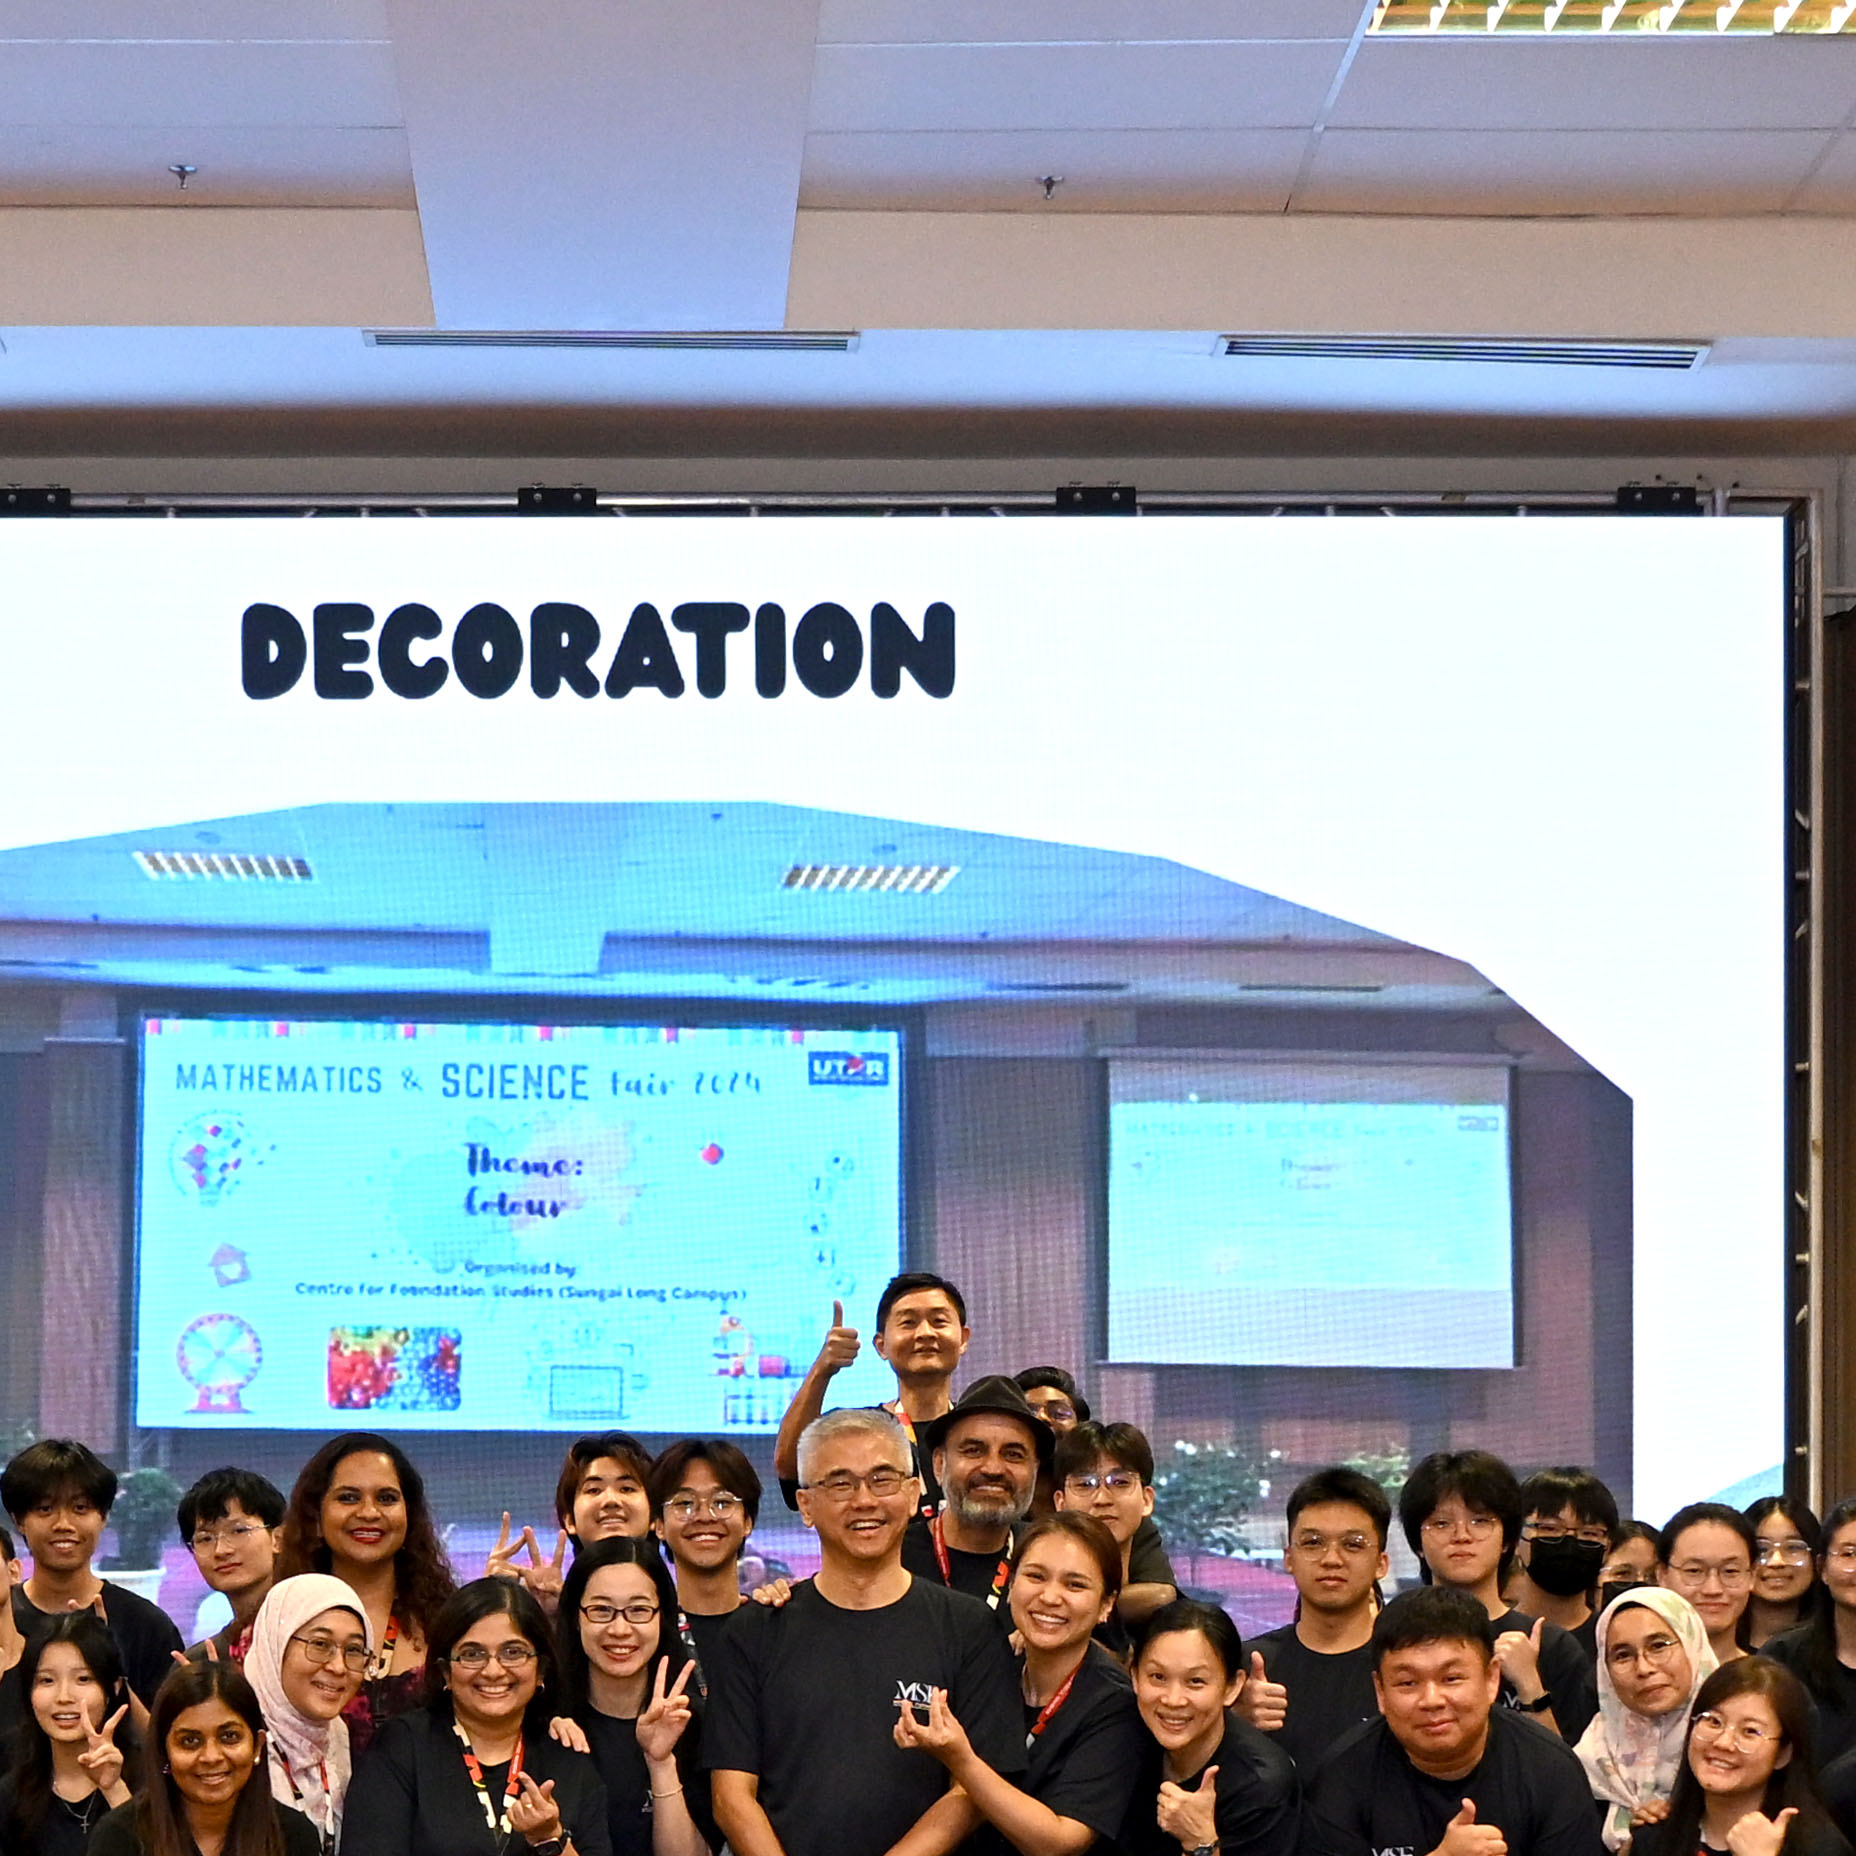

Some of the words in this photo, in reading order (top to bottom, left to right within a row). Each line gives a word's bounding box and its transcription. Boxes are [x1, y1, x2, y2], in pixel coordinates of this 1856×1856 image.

[241, 602, 956, 699] DECORATION
[175, 1063, 382, 1093] MATHEMATICS
[400, 1066, 423, 1093] &
[441, 1062, 589, 1101] SCIENCE
[463, 1142, 583, 1178] Theme:
[464, 1186, 567, 1218] Colour
